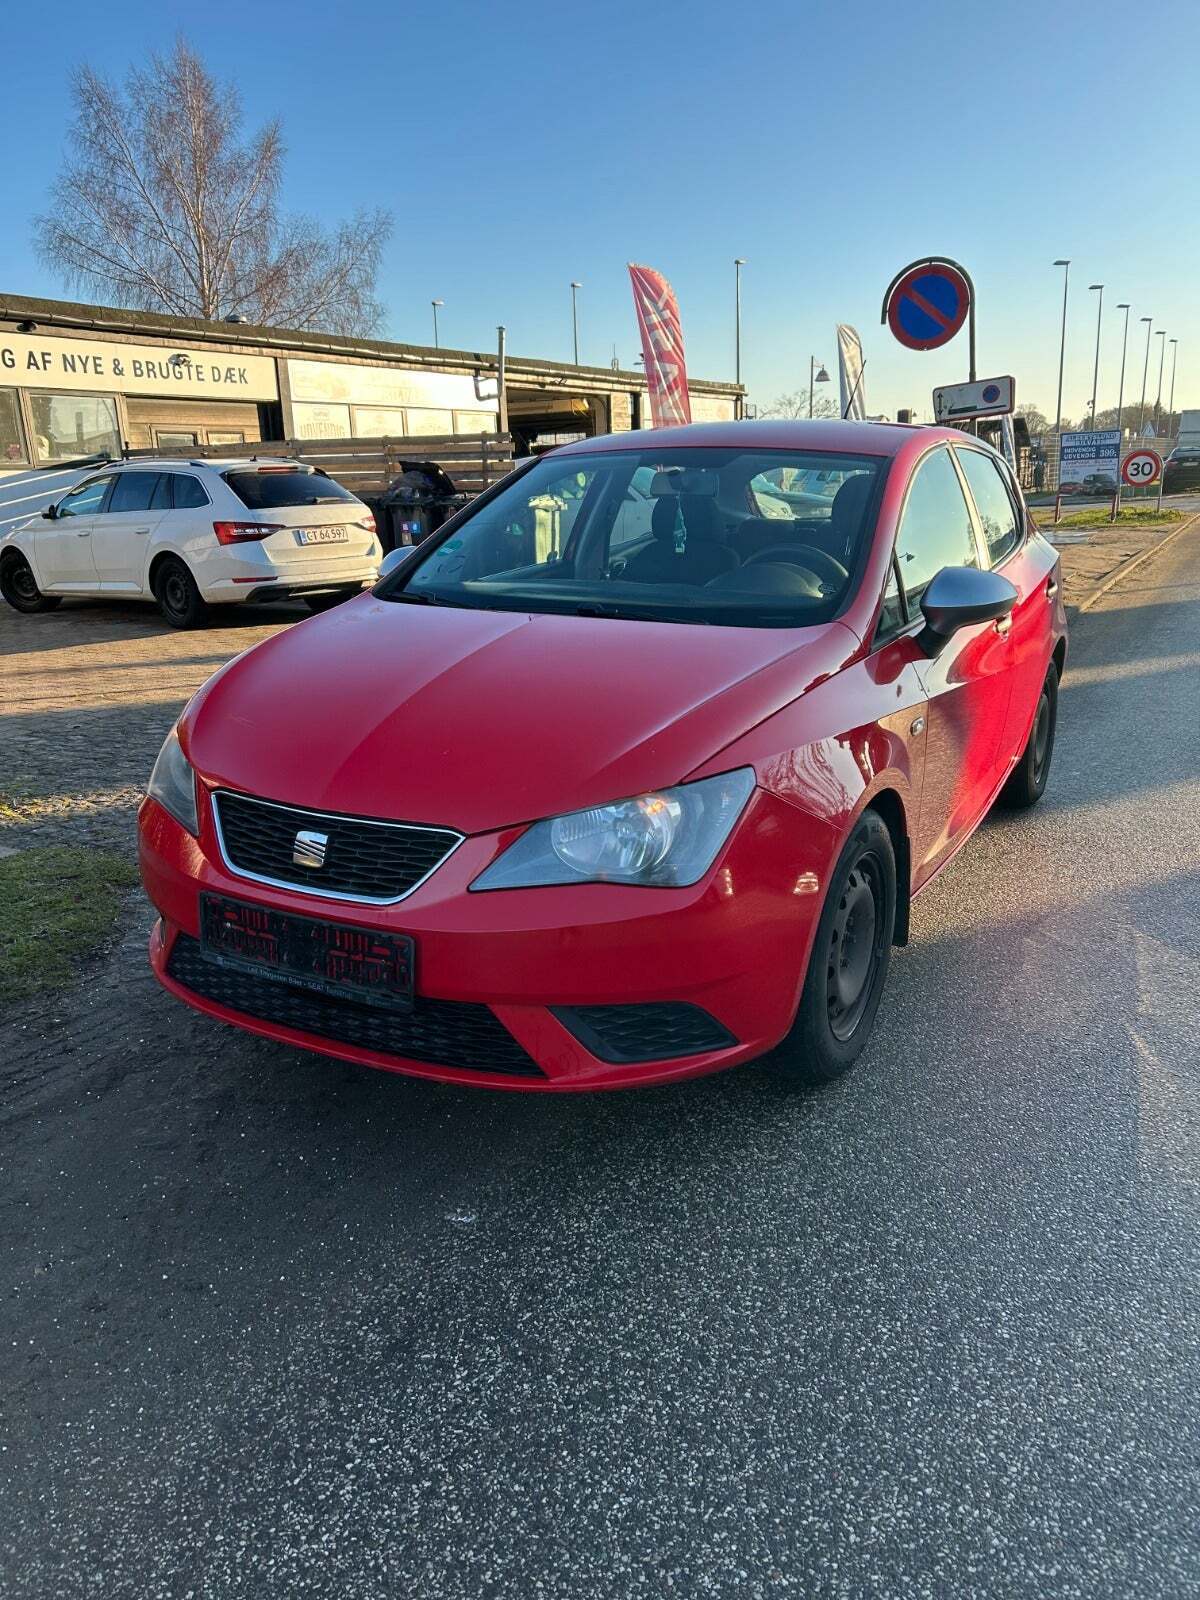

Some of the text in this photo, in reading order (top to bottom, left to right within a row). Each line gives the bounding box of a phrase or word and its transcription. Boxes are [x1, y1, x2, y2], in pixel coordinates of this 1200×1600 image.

[26, 350, 52, 371] AF
[62, 353, 104, 375] NYE
[112, 358, 125, 376] &
[132, 359, 205, 382] BRUGTE
[212, 365, 249, 384] DÆK
[1130, 462, 1153, 477] 30
[306, 528, 345, 541] CT 64 597
